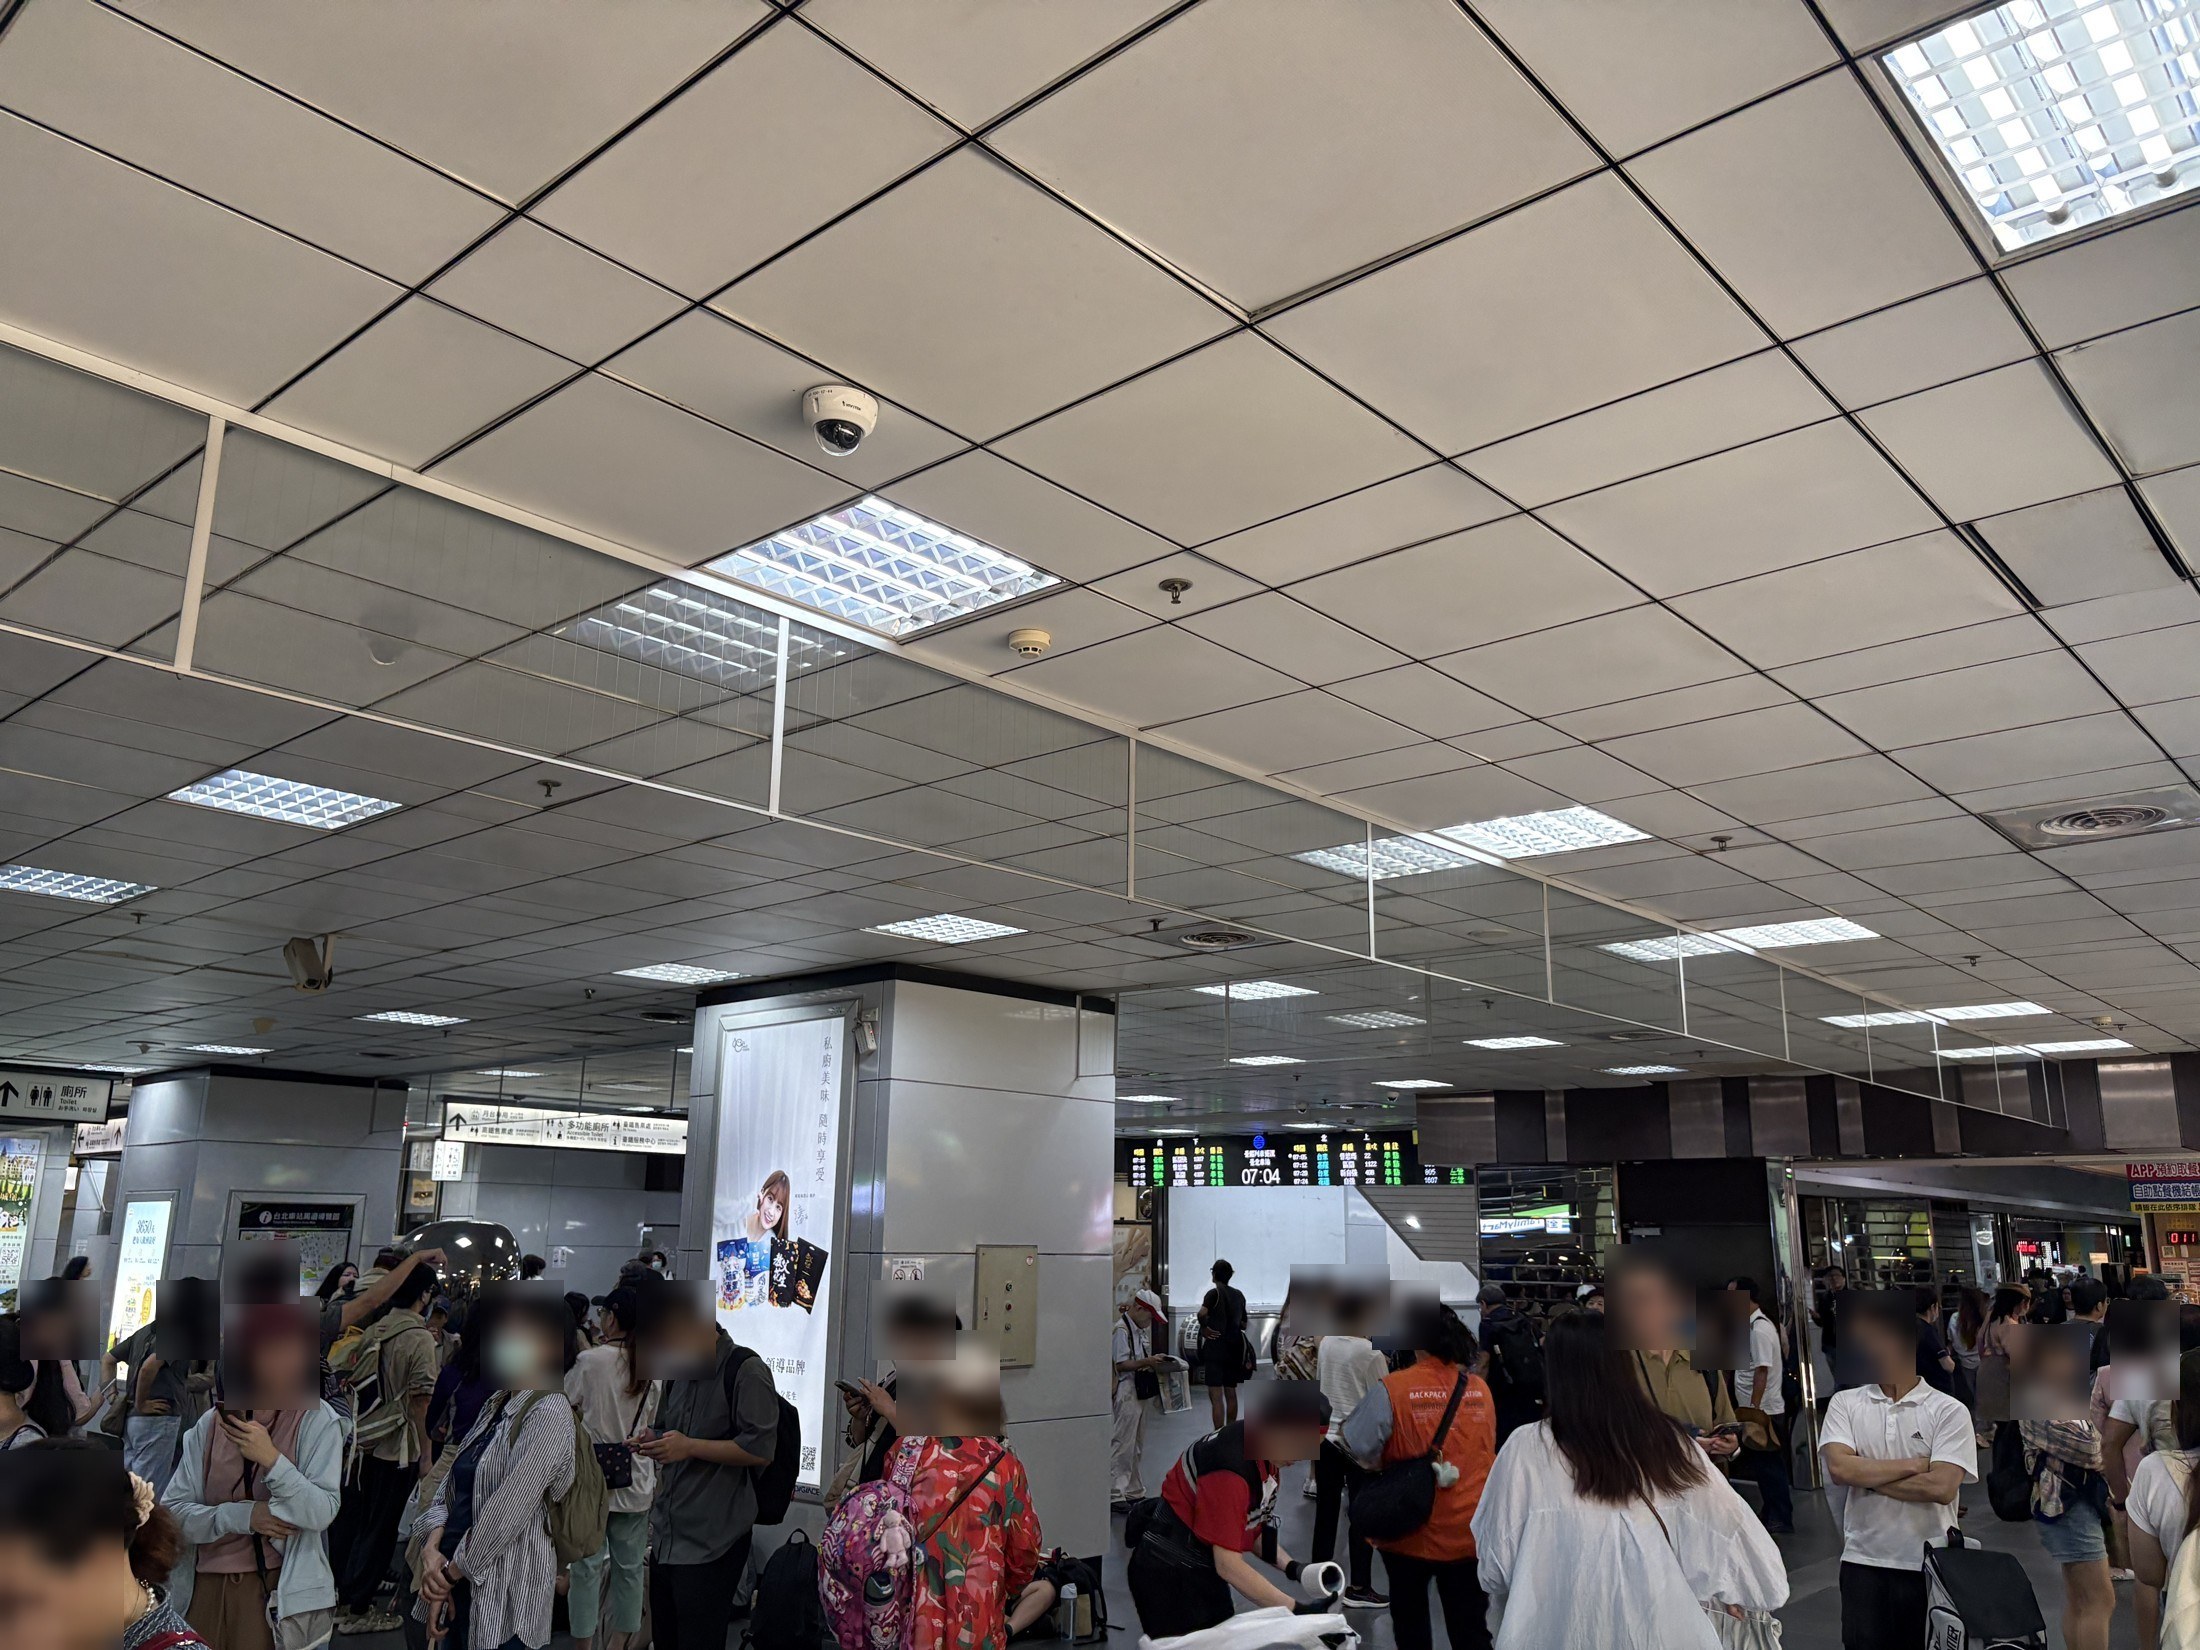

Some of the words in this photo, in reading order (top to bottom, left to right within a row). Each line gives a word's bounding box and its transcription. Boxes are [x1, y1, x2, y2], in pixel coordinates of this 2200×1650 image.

[820, 1036, 832, 1102] 私廚美味
[61, 1085, 87, 1099] 廁所
[567, 1120, 609, 1132] 多功能廁所
[1363, 1133, 1370, 1141] 上
[815, 1113, 828, 1182] 隨時享受
[1241, 1168, 1280, 1184] 07:04
[1409, 1391, 1447, 1399] BACKPACK
